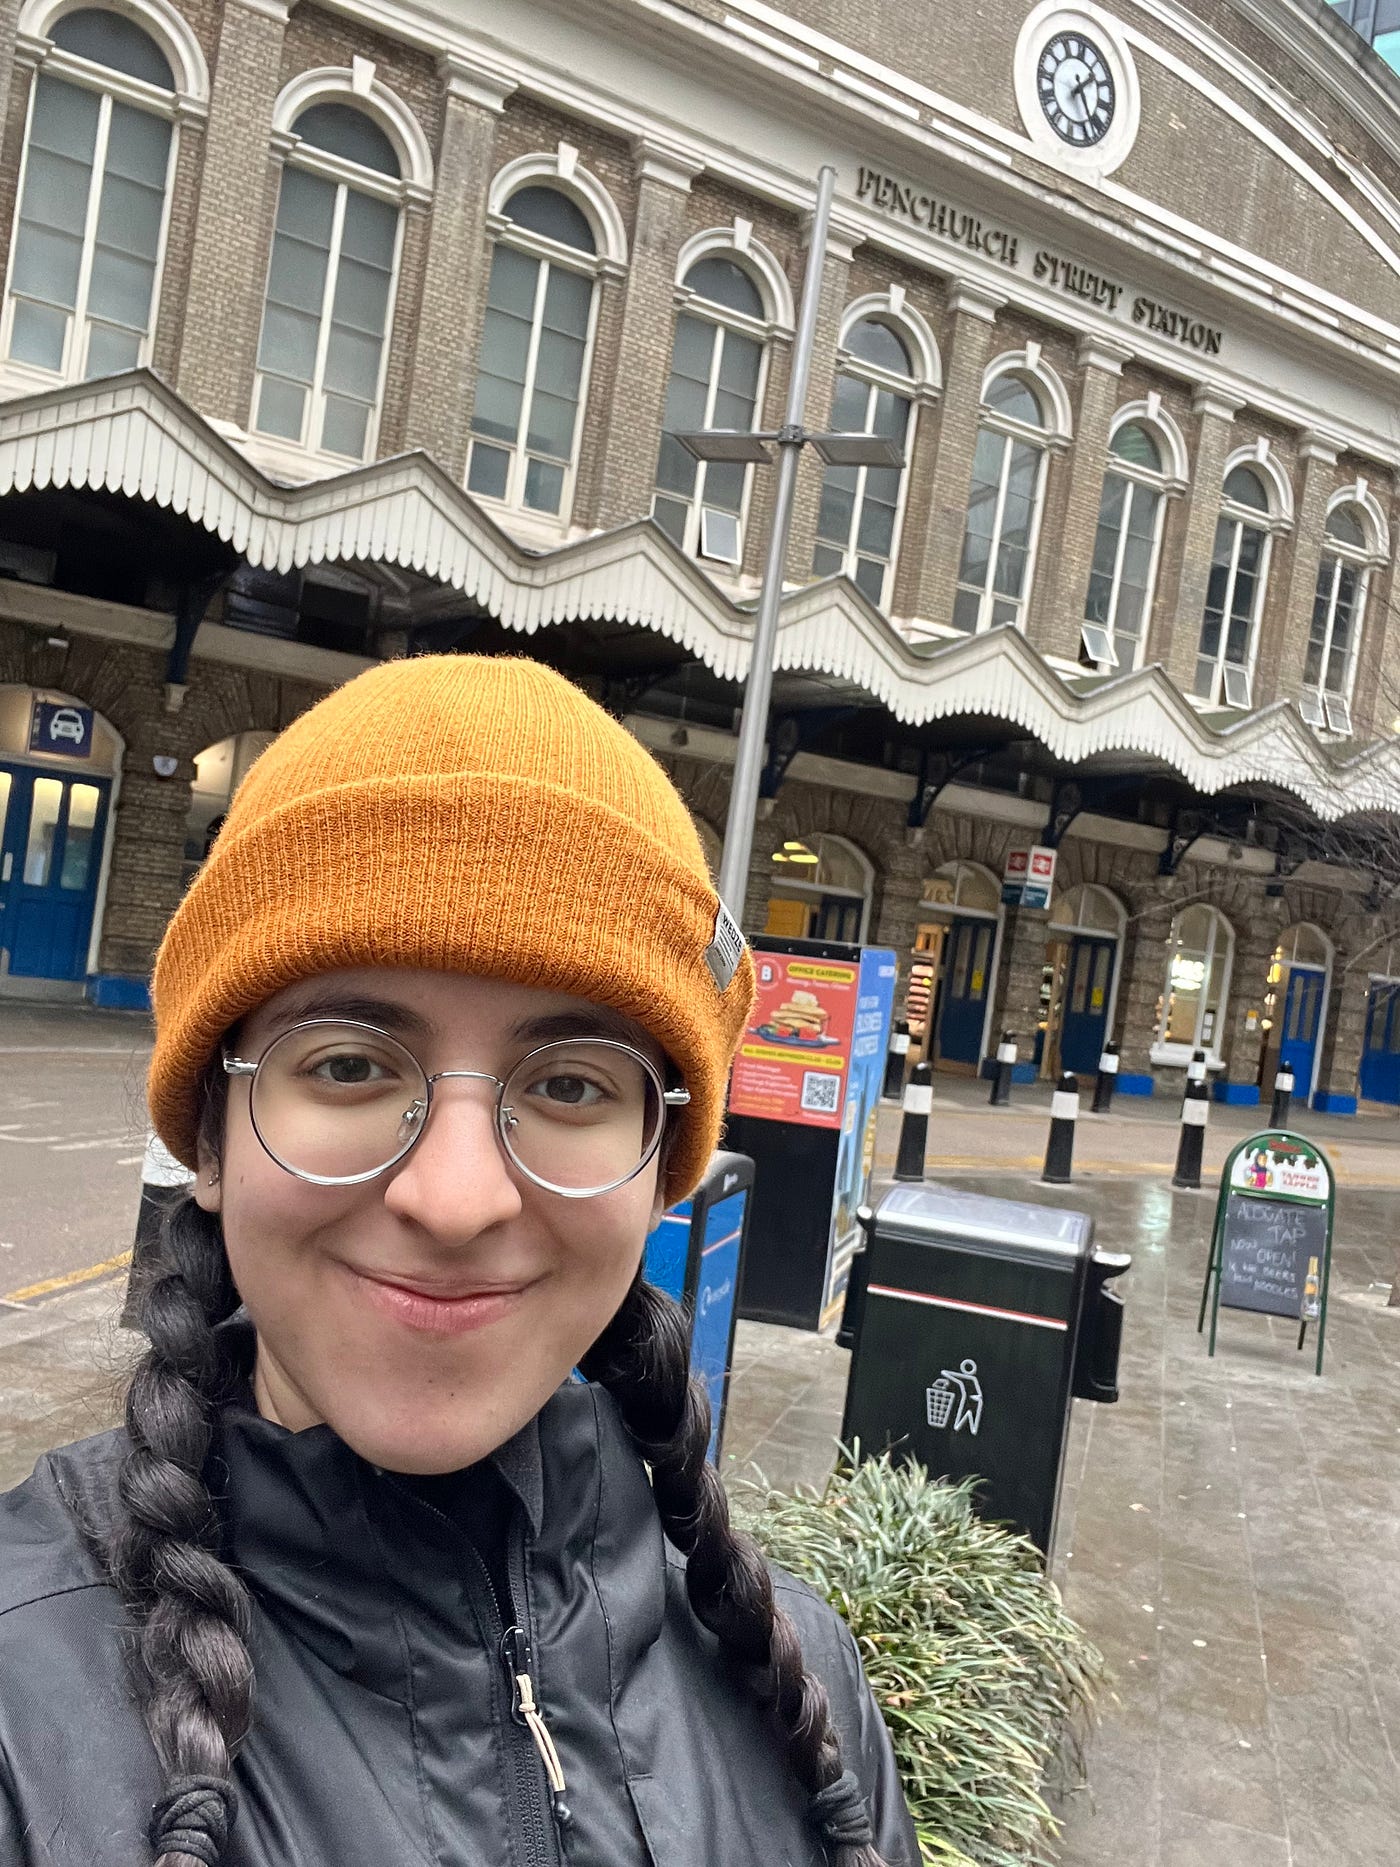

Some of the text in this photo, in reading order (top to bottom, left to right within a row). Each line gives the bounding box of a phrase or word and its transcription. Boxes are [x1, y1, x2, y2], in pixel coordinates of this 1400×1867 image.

[857, 166, 1223, 355] FENCHURCH STREET STATION
[722, 912, 743, 952] WEDZE
[1237, 1201, 1306, 1225] ALDGATE
[1267, 1224, 1306, 1247] TAP
